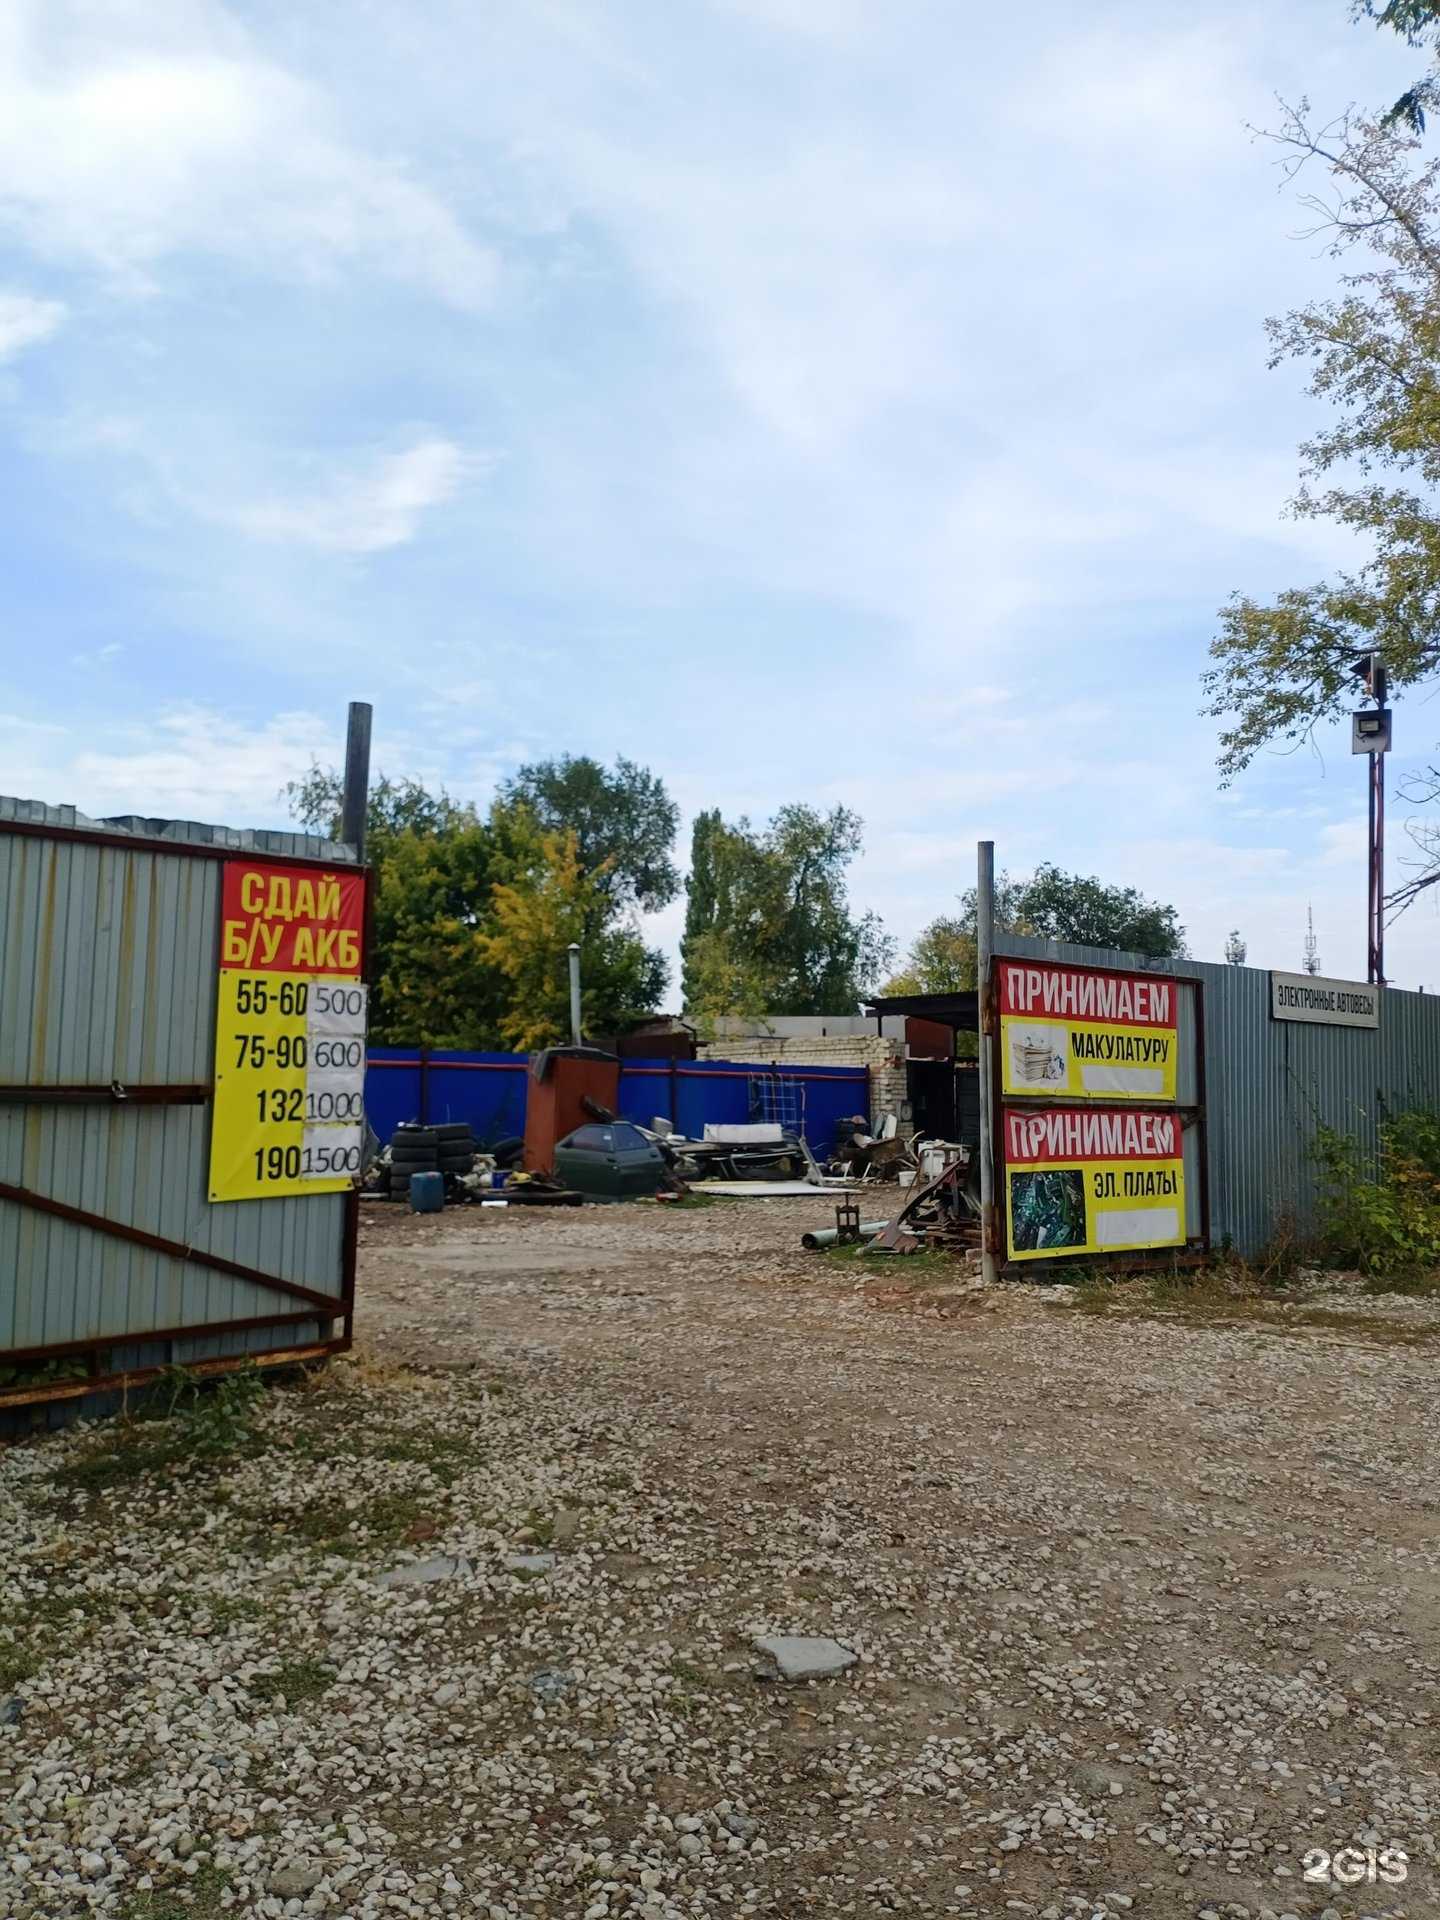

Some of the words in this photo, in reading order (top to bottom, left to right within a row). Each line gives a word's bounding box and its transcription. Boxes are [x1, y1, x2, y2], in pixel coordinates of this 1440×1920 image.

[241, 872, 341, 922] СДАЙ
[223, 917, 284, 968] Б/У
[292, 927, 360, 969] АКБ
[237, 979, 308, 1015] 55-60
[315, 988, 362, 1015] 500
[1007, 968, 1170, 1023] ПРИНИМАЕМ
[1278, 985, 1335, 1012] ЭЛЕКТРОННЫЕ
[1336, 991, 1374, 1016] АВТОВЕСЫ
[235, 1034, 308, 1069] 75-90
[315, 1042, 362, 1068] 600
[1071, 1032, 1169, 1063] МАКУЛАТУРУ
[257, 1088, 304, 1122] 132
[306, 1092, 363, 1120] 1000
[1010, 1114, 1174, 1158] ПРИНИМАЕМ
[255, 1145, 300, 1181] 190
[302, 1146, 361, 1173] 1500
[1094, 1172, 1121, 1198] ЭЛ.
[1124, 1170, 1177, 1197] ПЛАТЫ
